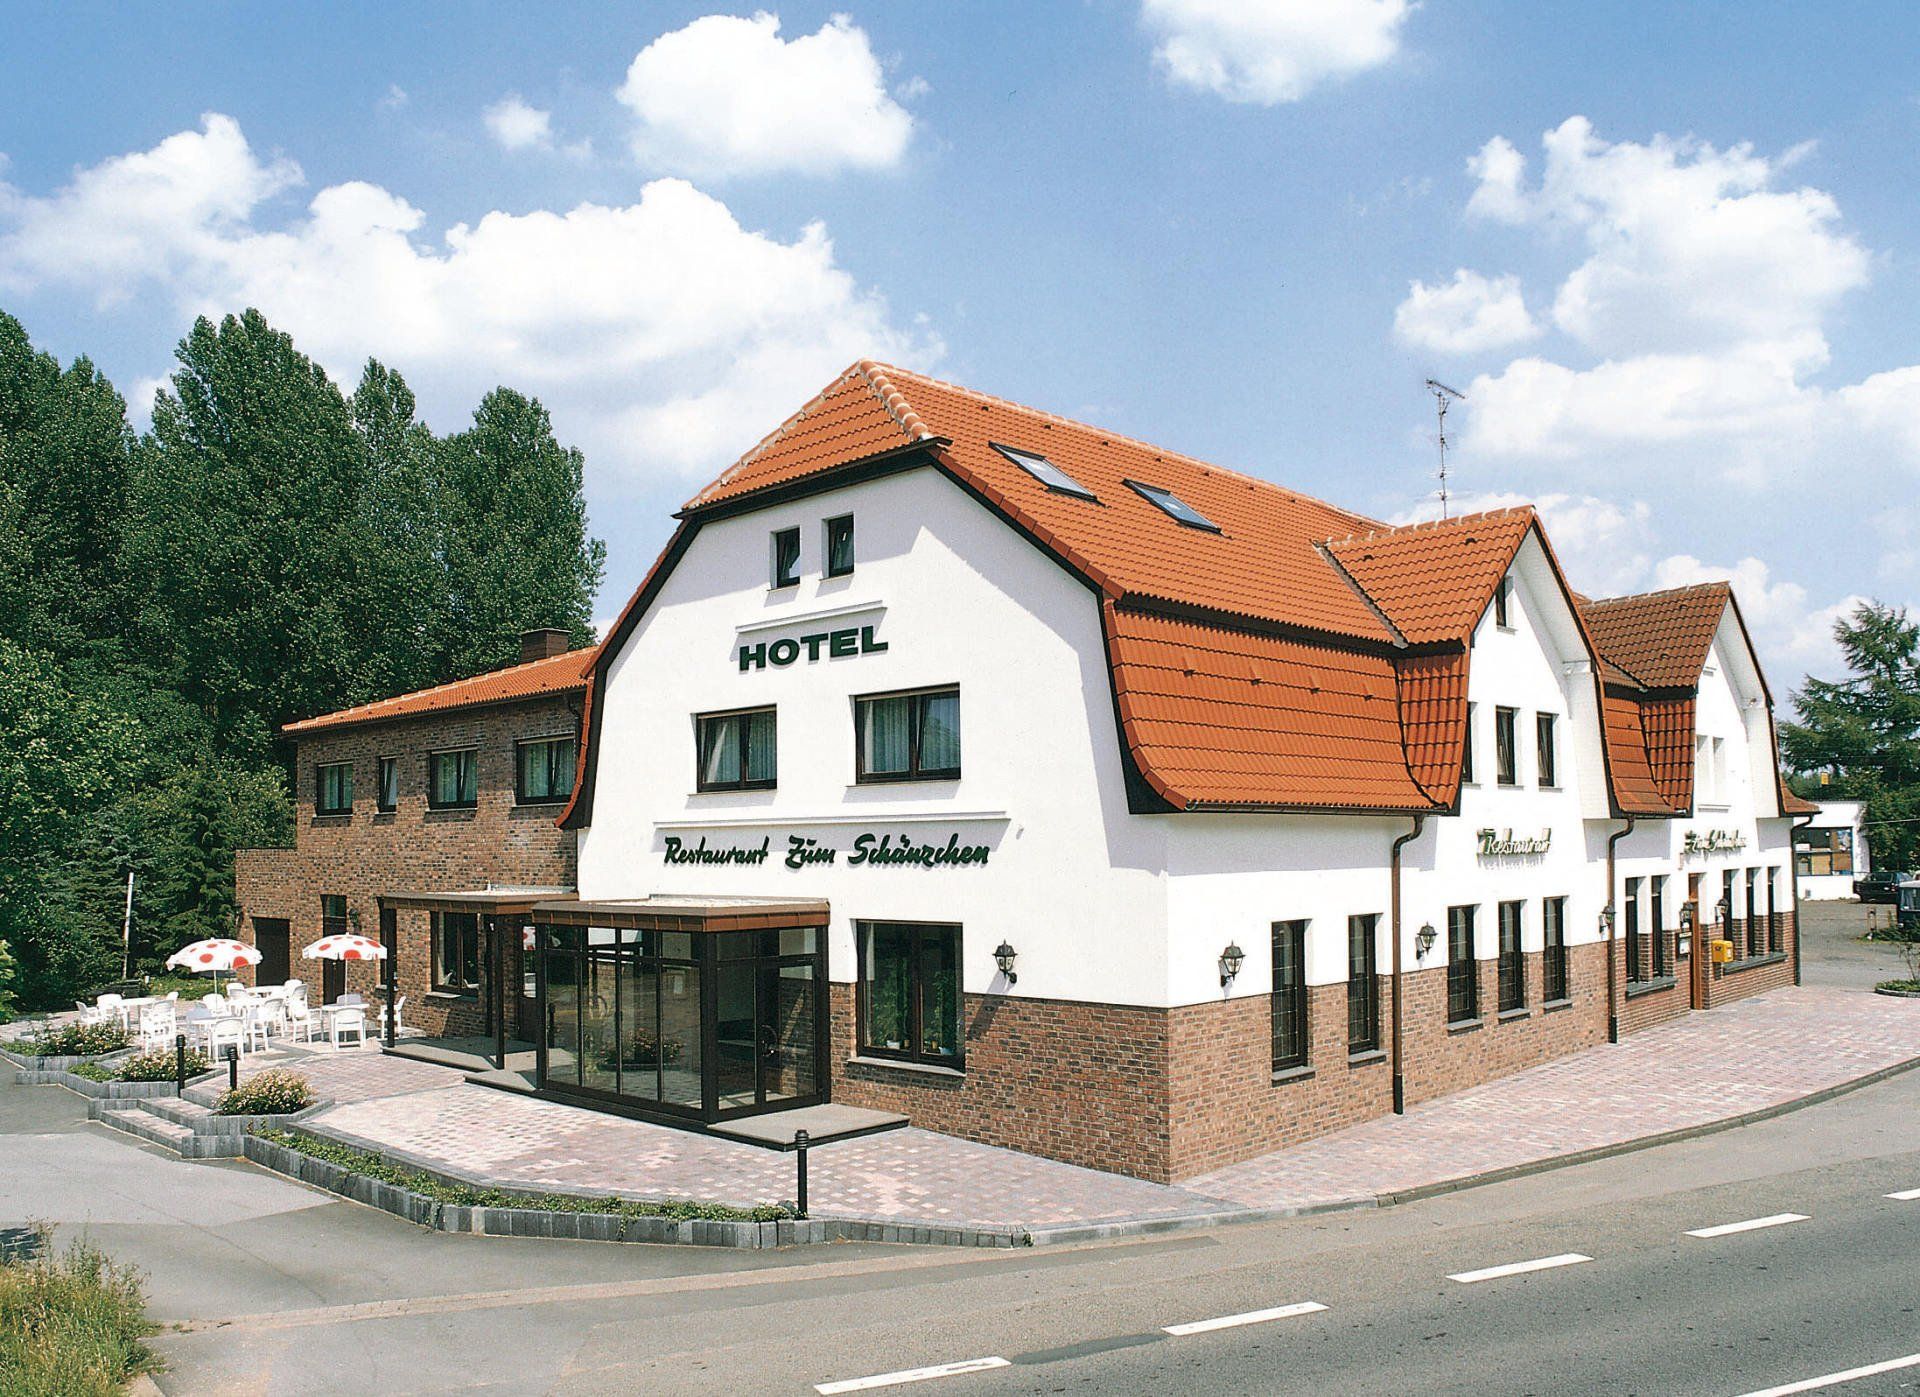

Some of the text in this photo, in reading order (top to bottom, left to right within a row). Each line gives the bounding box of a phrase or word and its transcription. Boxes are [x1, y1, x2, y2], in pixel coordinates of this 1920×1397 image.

[739, 625, 889, 671] HOTEL
[664, 835, 770, 864] Restaurant
[848, 833, 991, 867] Schänzchen
